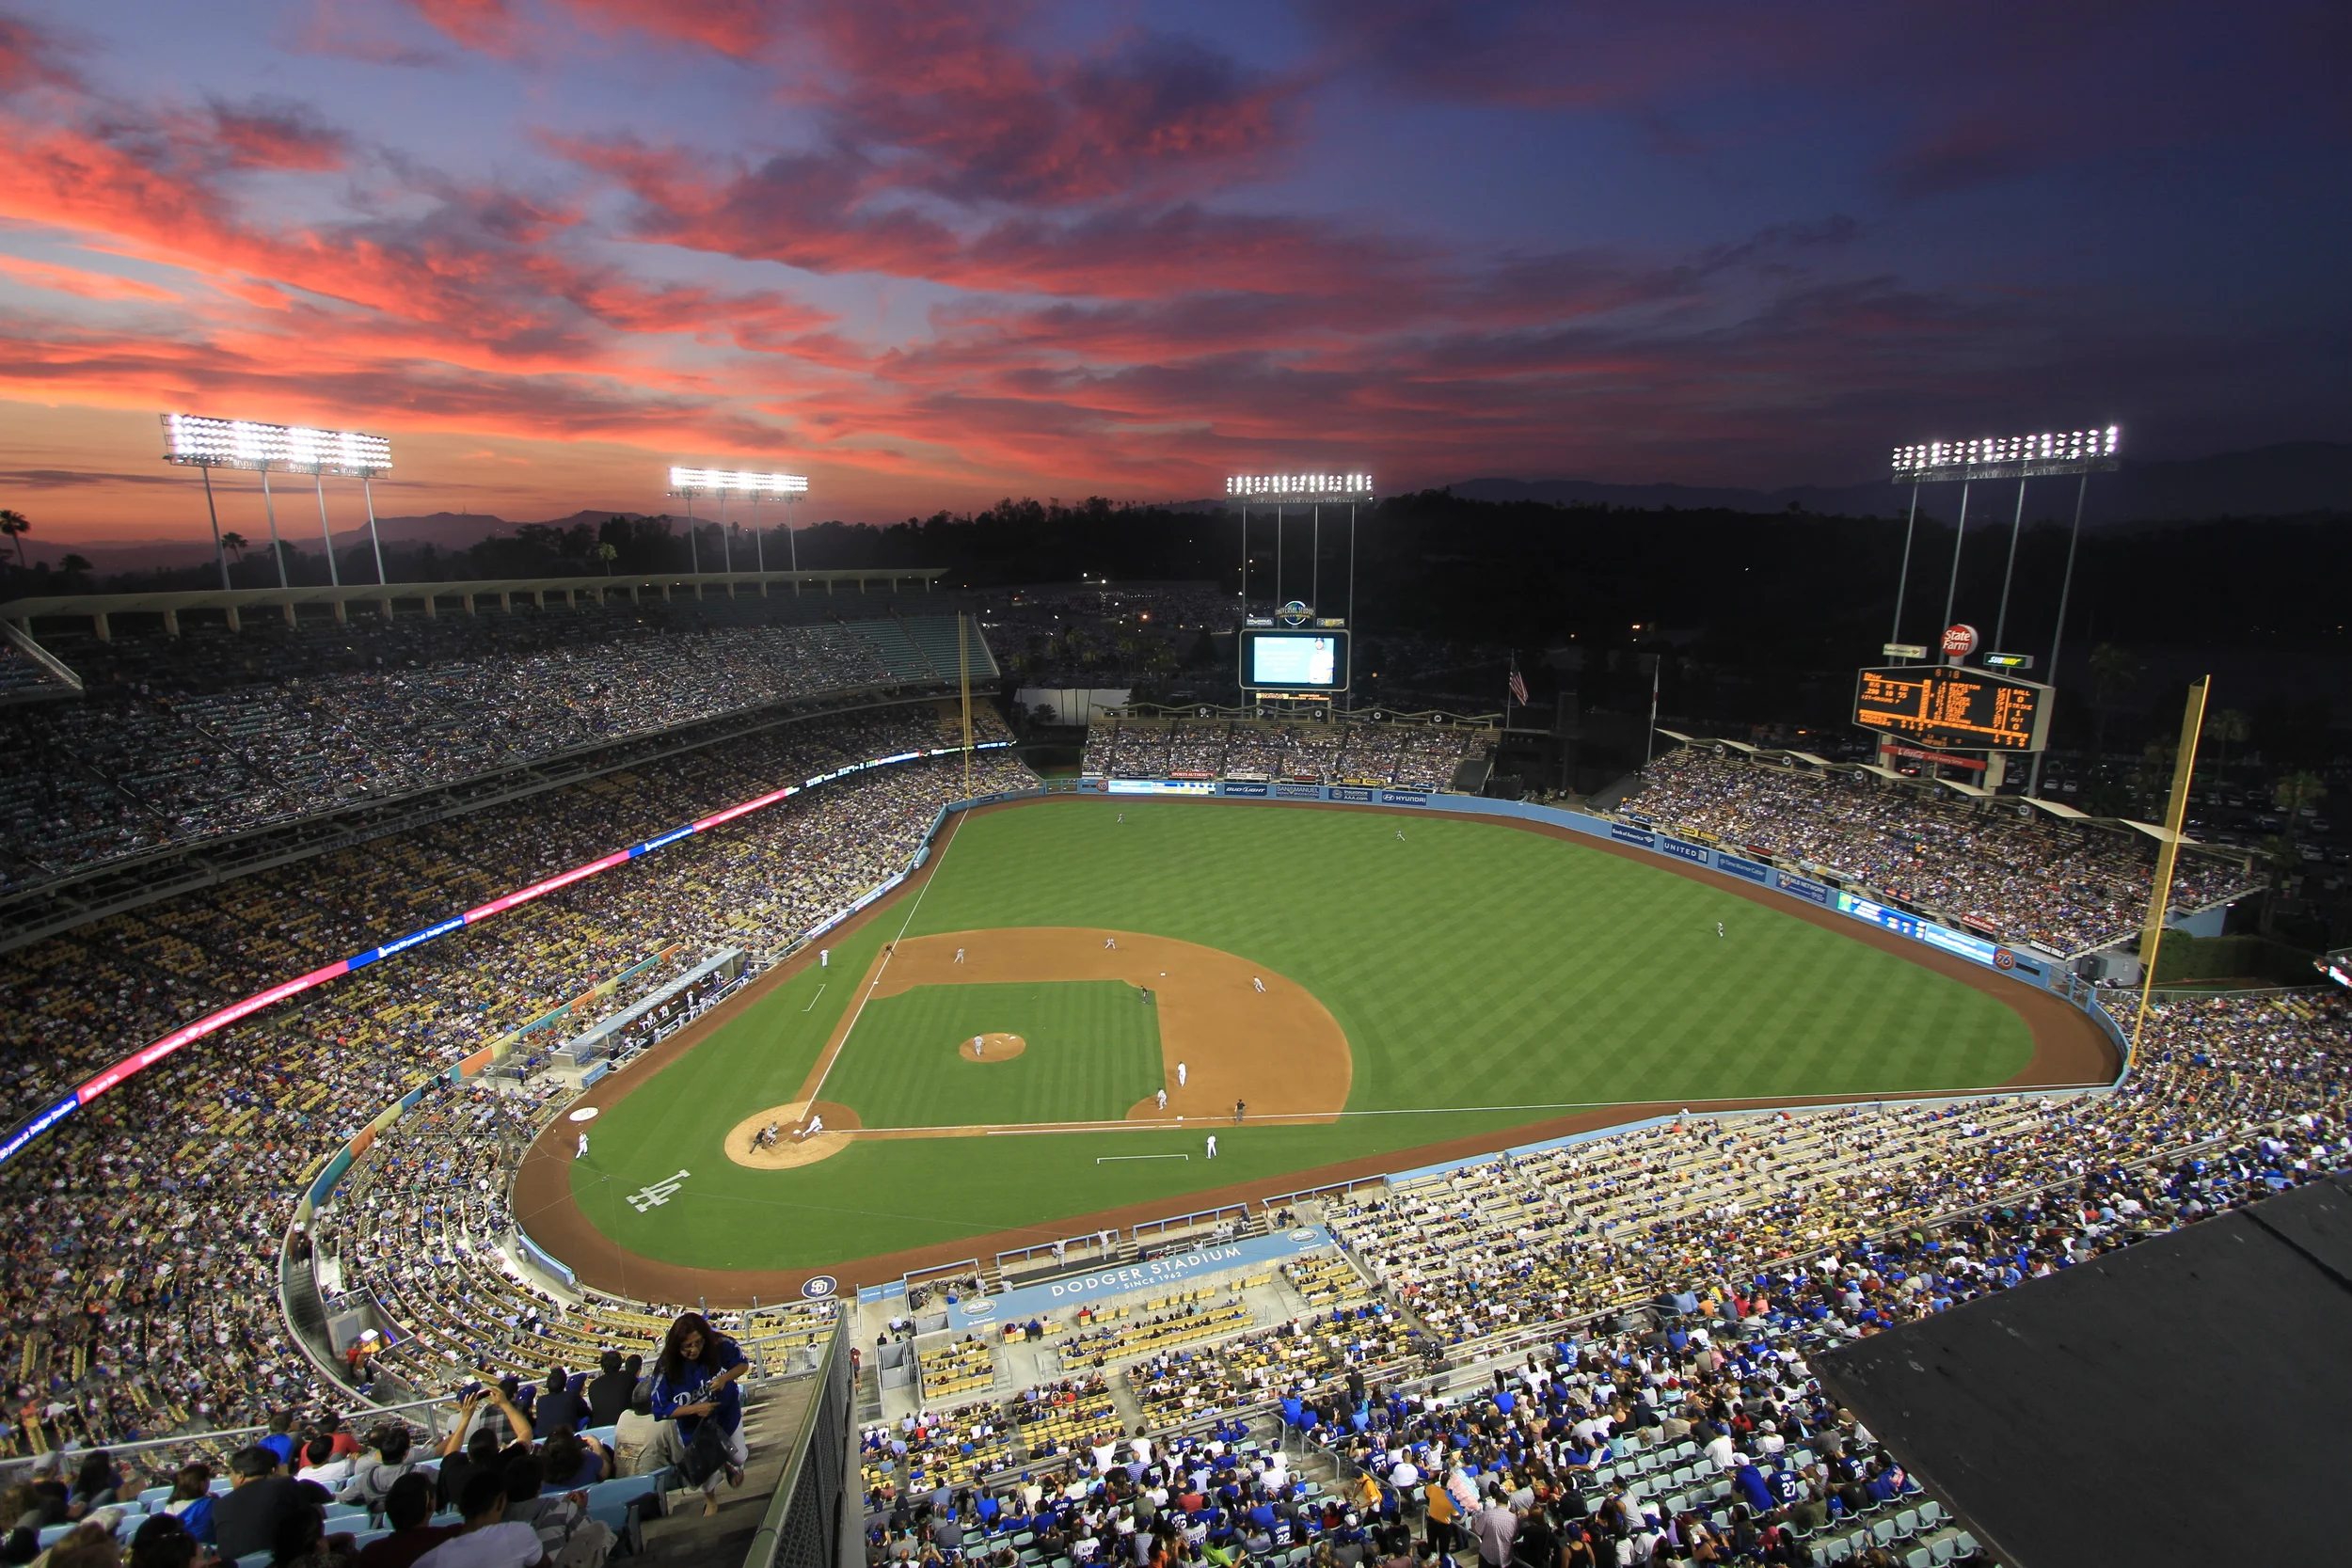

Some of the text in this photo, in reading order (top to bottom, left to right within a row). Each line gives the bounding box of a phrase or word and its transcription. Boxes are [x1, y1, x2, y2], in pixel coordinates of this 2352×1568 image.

[1945, 629, 1971, 641] State
[1943, 640, 1969, 651] Farm
[1987, 656, 2024, 665] SUBWAY
[1627, 832, 1645, 841] America
[1664, 842, 1697, 857] UNITED
[2051, 946, 2067, 958] MILK
[1995, 953, 2011, 966] 76
[8, 1136, 24, 1155] years
[29, 1117, 52, 1135] Dodger
[51, 1100, 76, 1119] Stadium
[1051, 1245, 1242, 1297] DODGER STADIUM
[811, 1279, 828, 1294] SD
[1123, 1271, 1183, 1290] SINCE 1962
[673, 1367, 728, 1406] Dodrs
[1854, 1465, 1864, 1478] 16
[1781, 1481, 1796, 1497] 27
[1277, 1532, 1291, 1544] 22
